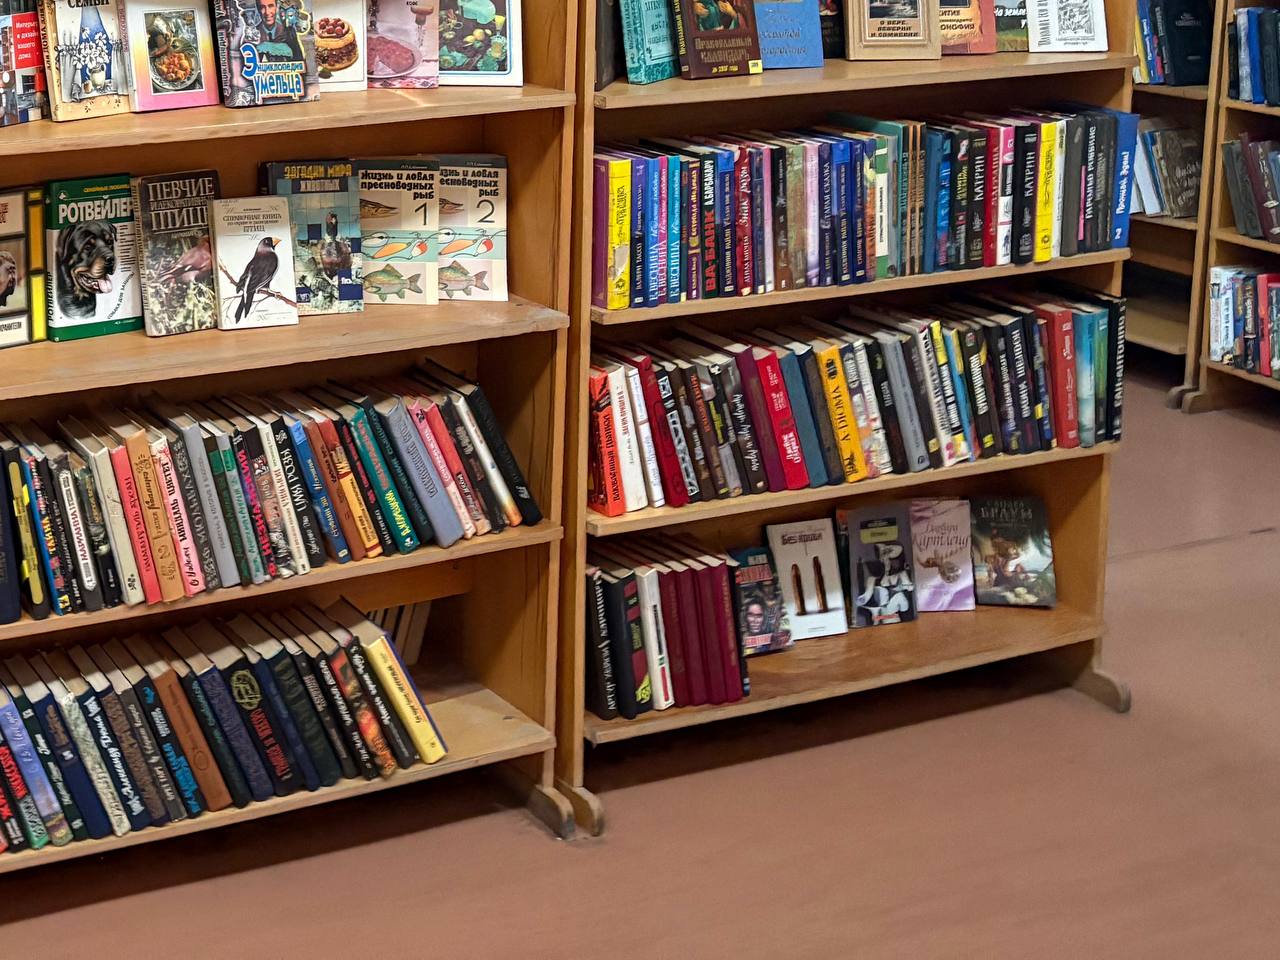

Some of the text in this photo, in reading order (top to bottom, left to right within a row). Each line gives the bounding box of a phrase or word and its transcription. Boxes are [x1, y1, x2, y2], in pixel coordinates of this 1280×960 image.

[253, 74, 303, 99] умельца
[360, 180, 434, 192] пресноводных
[361, 172, 395, 181] Жизнь
[405, 173, 434, 181] ловля
[471, 170, 499, 179] ловля
[973, 155, 985, 201] КАТРИН
[1025, 151, 1036, 197] КАТРИН
[148, 178, 214, 202] ПЕВЧИЕ
[413, 190, 434, 201] рыб
[478, 188, 499, 198] рыб
[58, 196, 134, 224] РОТВЕЙЛЕР
[414, 203, 428, 225] 1
[477, 199, 495, 224] 2
[704, 159, 716, 291] ВА-БАНК А.БАРБАКАРУ
[281, 439, 307, 512] ИМЯ РОЗЫ
[162, 462, 187, 541] МИНДАЛЬ ЦВЕТЕТ
[70, 511, 89, 561] МАРИАННА
